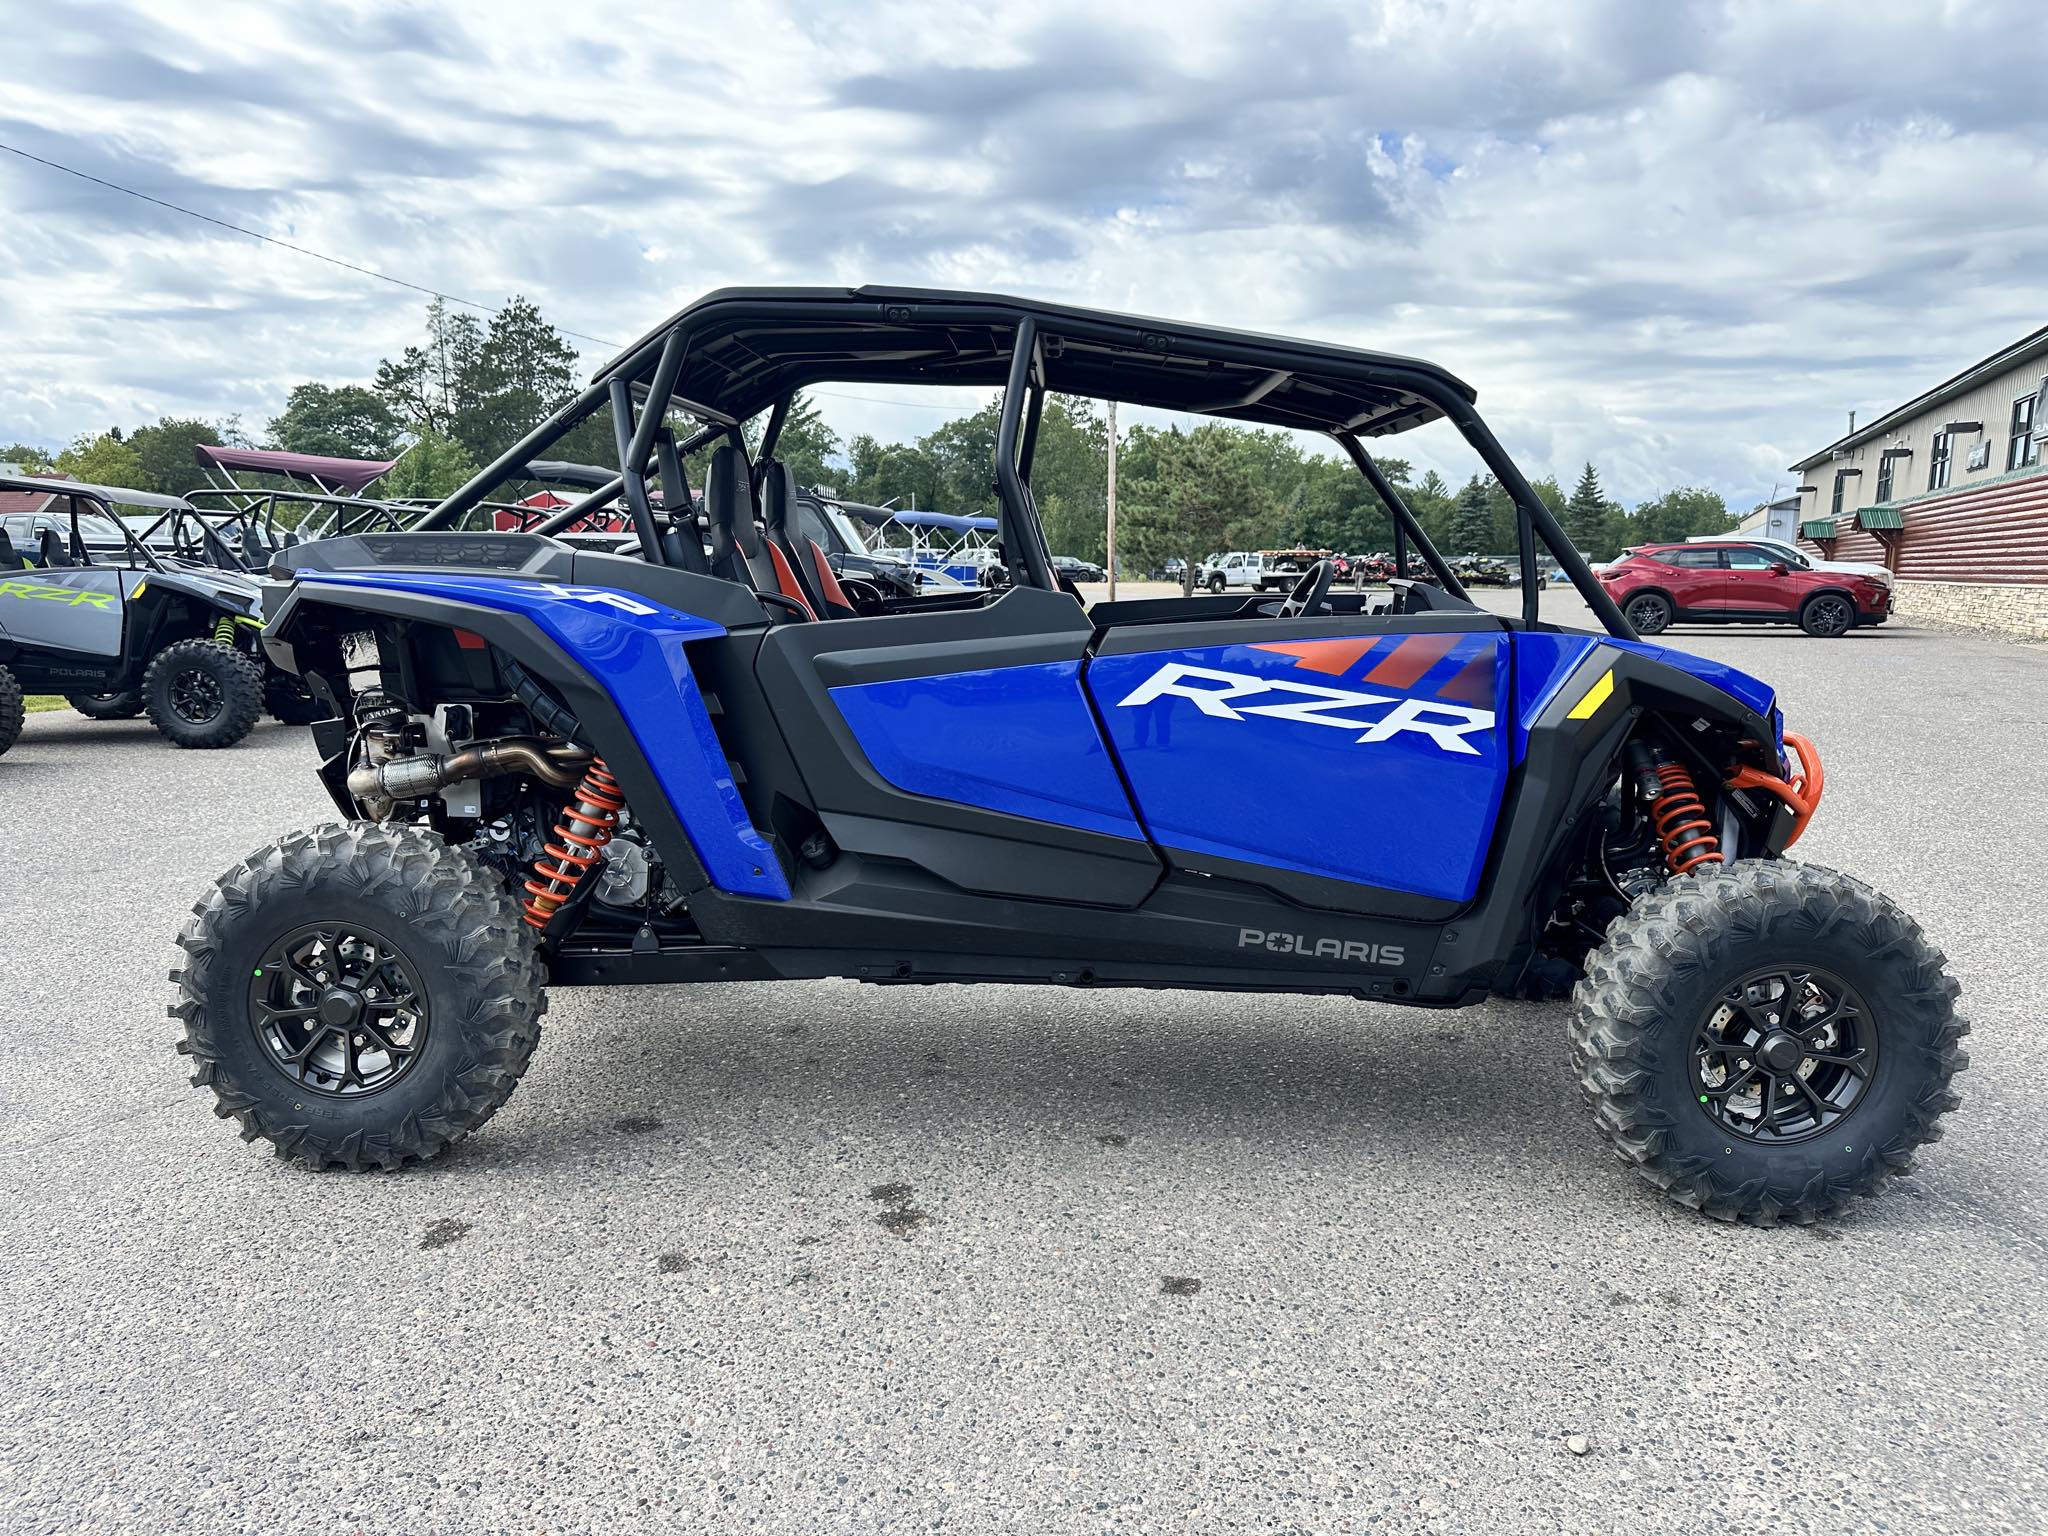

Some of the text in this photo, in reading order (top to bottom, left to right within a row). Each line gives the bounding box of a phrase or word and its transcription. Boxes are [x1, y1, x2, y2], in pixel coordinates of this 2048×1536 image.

[0, 581, 116, 609] RZR
[507, 583, 660, 616] XP
[49, 667, 107, 678] POLARIS
[1116, 662, 1496, 756] RZR
[1237, 928, 1406, 967] POLARIS
